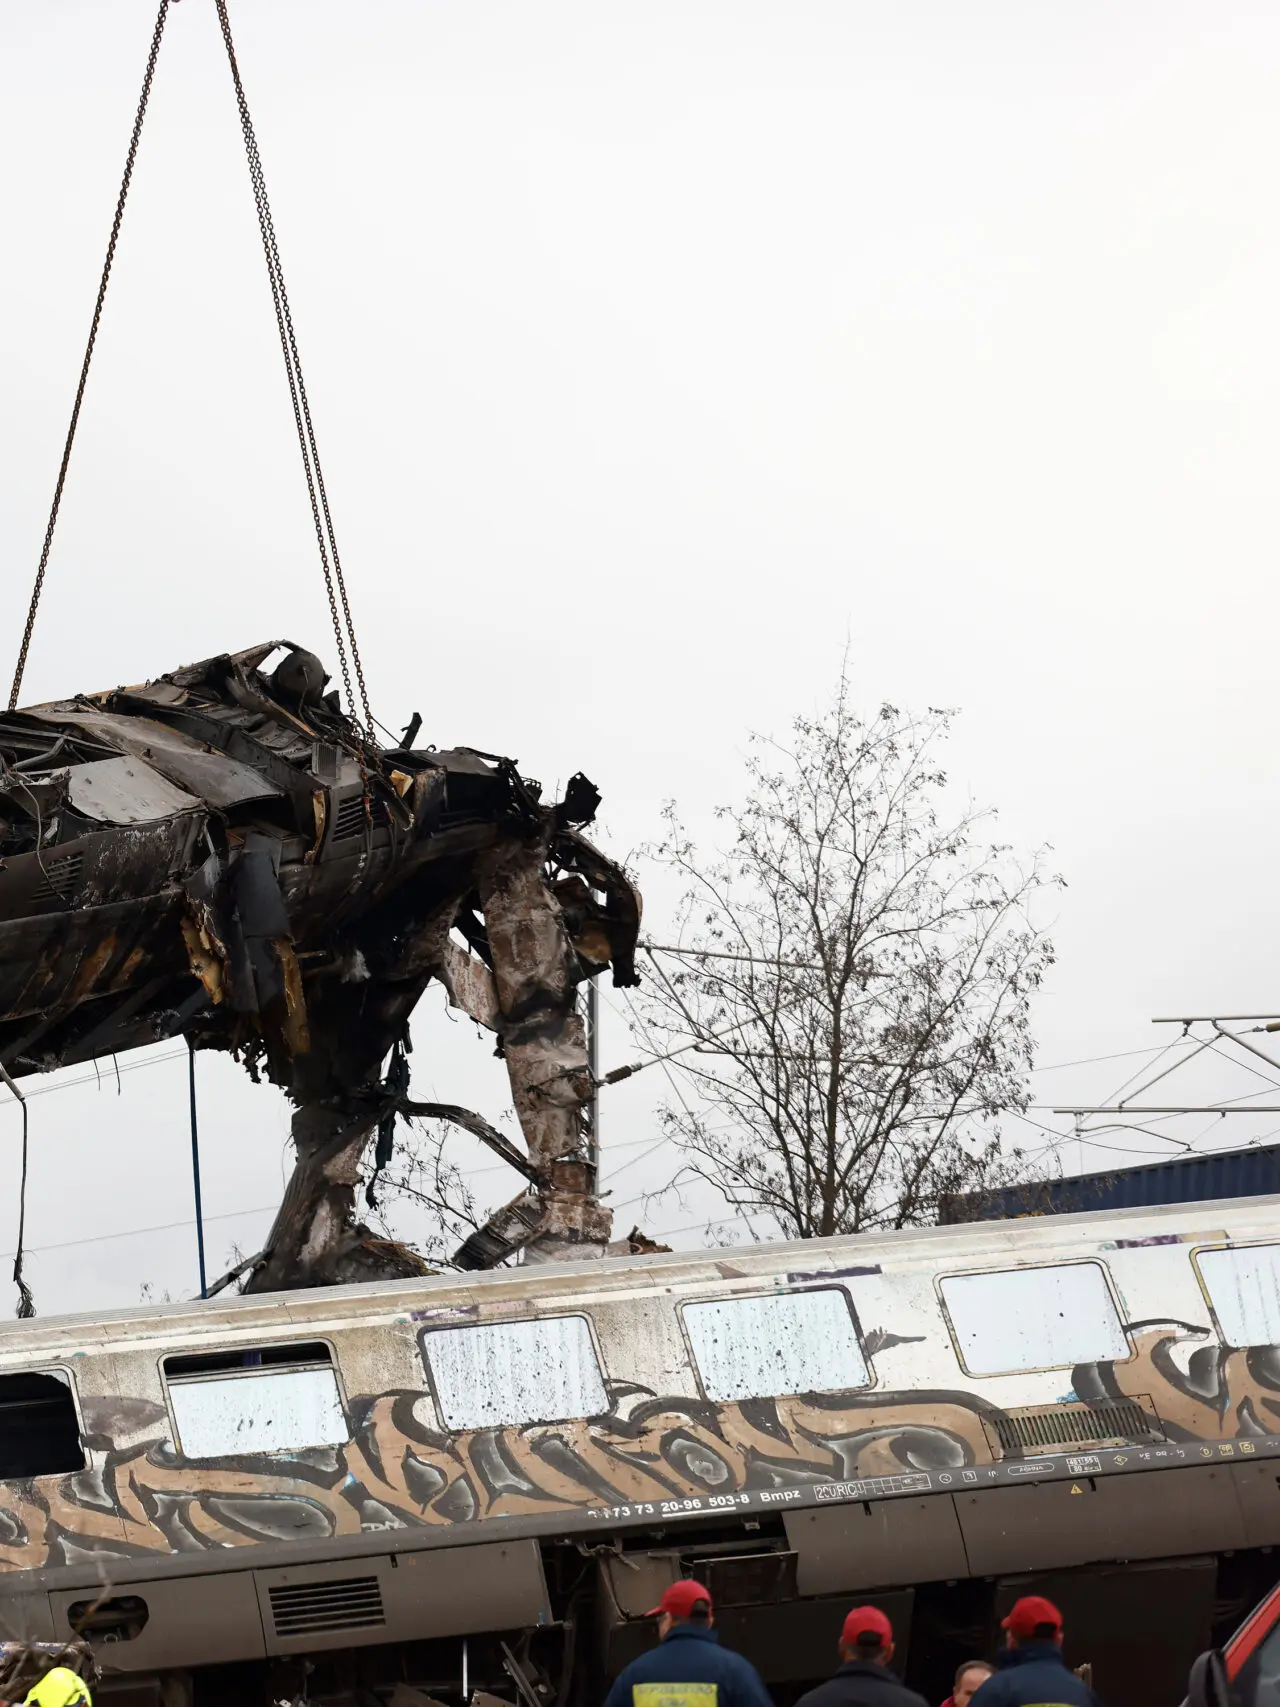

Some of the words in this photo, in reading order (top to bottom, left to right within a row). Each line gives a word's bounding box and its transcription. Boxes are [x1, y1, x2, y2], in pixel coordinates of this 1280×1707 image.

[634, 1503, 655, 1515] 73
[662, 1498, 702, 1512] 20-96
[708, 1494, 750, 1507] 503-8
[759, 1489, 801, 1502] Bmpz
